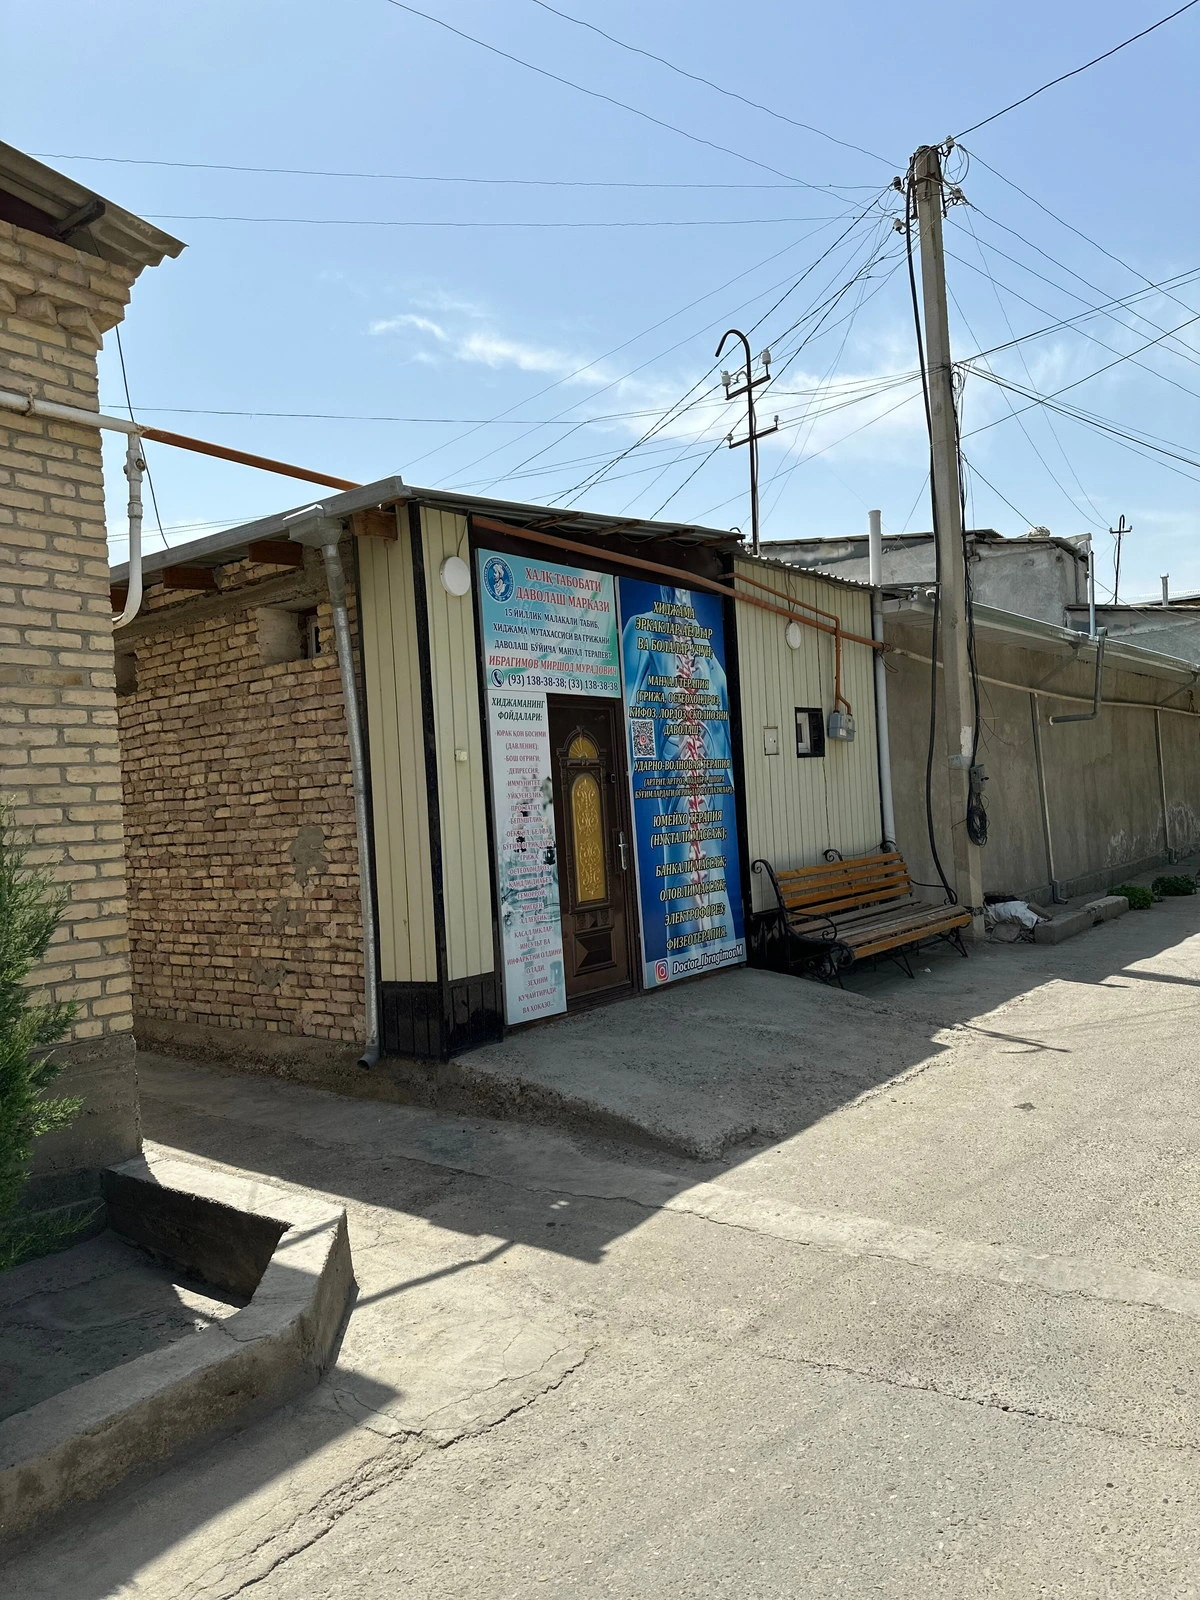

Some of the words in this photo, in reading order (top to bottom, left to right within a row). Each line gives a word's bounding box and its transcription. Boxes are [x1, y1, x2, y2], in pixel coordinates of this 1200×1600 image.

[525, 568, 553, 585] ХАЛҚ
[555, 574, 601, 592] ТАБОБАТИ
[516, 587, 566, 605] ДАВОЛАШ
[568, 596, 609, 612] МАРКАЗИ
[505, 608, 512, 616] 15
[514, 608, 542, 620] ЙИЛЛИК
[544, 614, 578, 626] МАЛАКАЛИ
[652, 601, 695, 619] ХИДЖАМА
[493, 623, 528, 635] ХИДЖАМА
[530, 628, 573, 639] МУТАХАССИСИ
[583, 635, 609, 644] ГРИЖАНИ
[495, 640, 528, 650] ДАВОЛАШ
[531, 642, 556, 654] БЎЙИЧА
[558, 647, 582, 656] МАНУАЛ
[585, 650, 611, 659] ТЕРАПЕВТ
[637, 637, 649, 650] ВА
[651, 639, 690, 655] БОЛАЛАР
[489, 655, 538, 669] ИБРАГИМОВ
[541, 660, 574, 674] МИРШОД
[576, 664, 616, 675] МУРАДОВИЧ
[508, 674, 524, 687] (93)
[527, 676, 566, 688] 138-38-38;
[568, 678, 582, 690] (33)
[585, 679, 618, 691] 138-38-38
[647, 676, 678, 687] МАНУАЛ
[678, 677, 709, 689] ТЕРАПИЯ
[492, 698, 545, 709] ХИДЖАМАНИНГ
[629, 706, 658, 719] КИФОЗ,
[498, 712, 543, 721] ФОЙДАЛАРИ:
[634, 760, 702, 772] УДАРНО-ВОЛНОВАЯ
[703, 759, 731, 769] ТЕРАПИЯ
[653, 812, 688, 827] ЮМЕЙХО
[689, 810, 722, 824] ТЕРАПИЯ
[655, 859, 694, 877] БАНКАЛИ
[659, 886, 693, 902] ОЛОВЛИ
